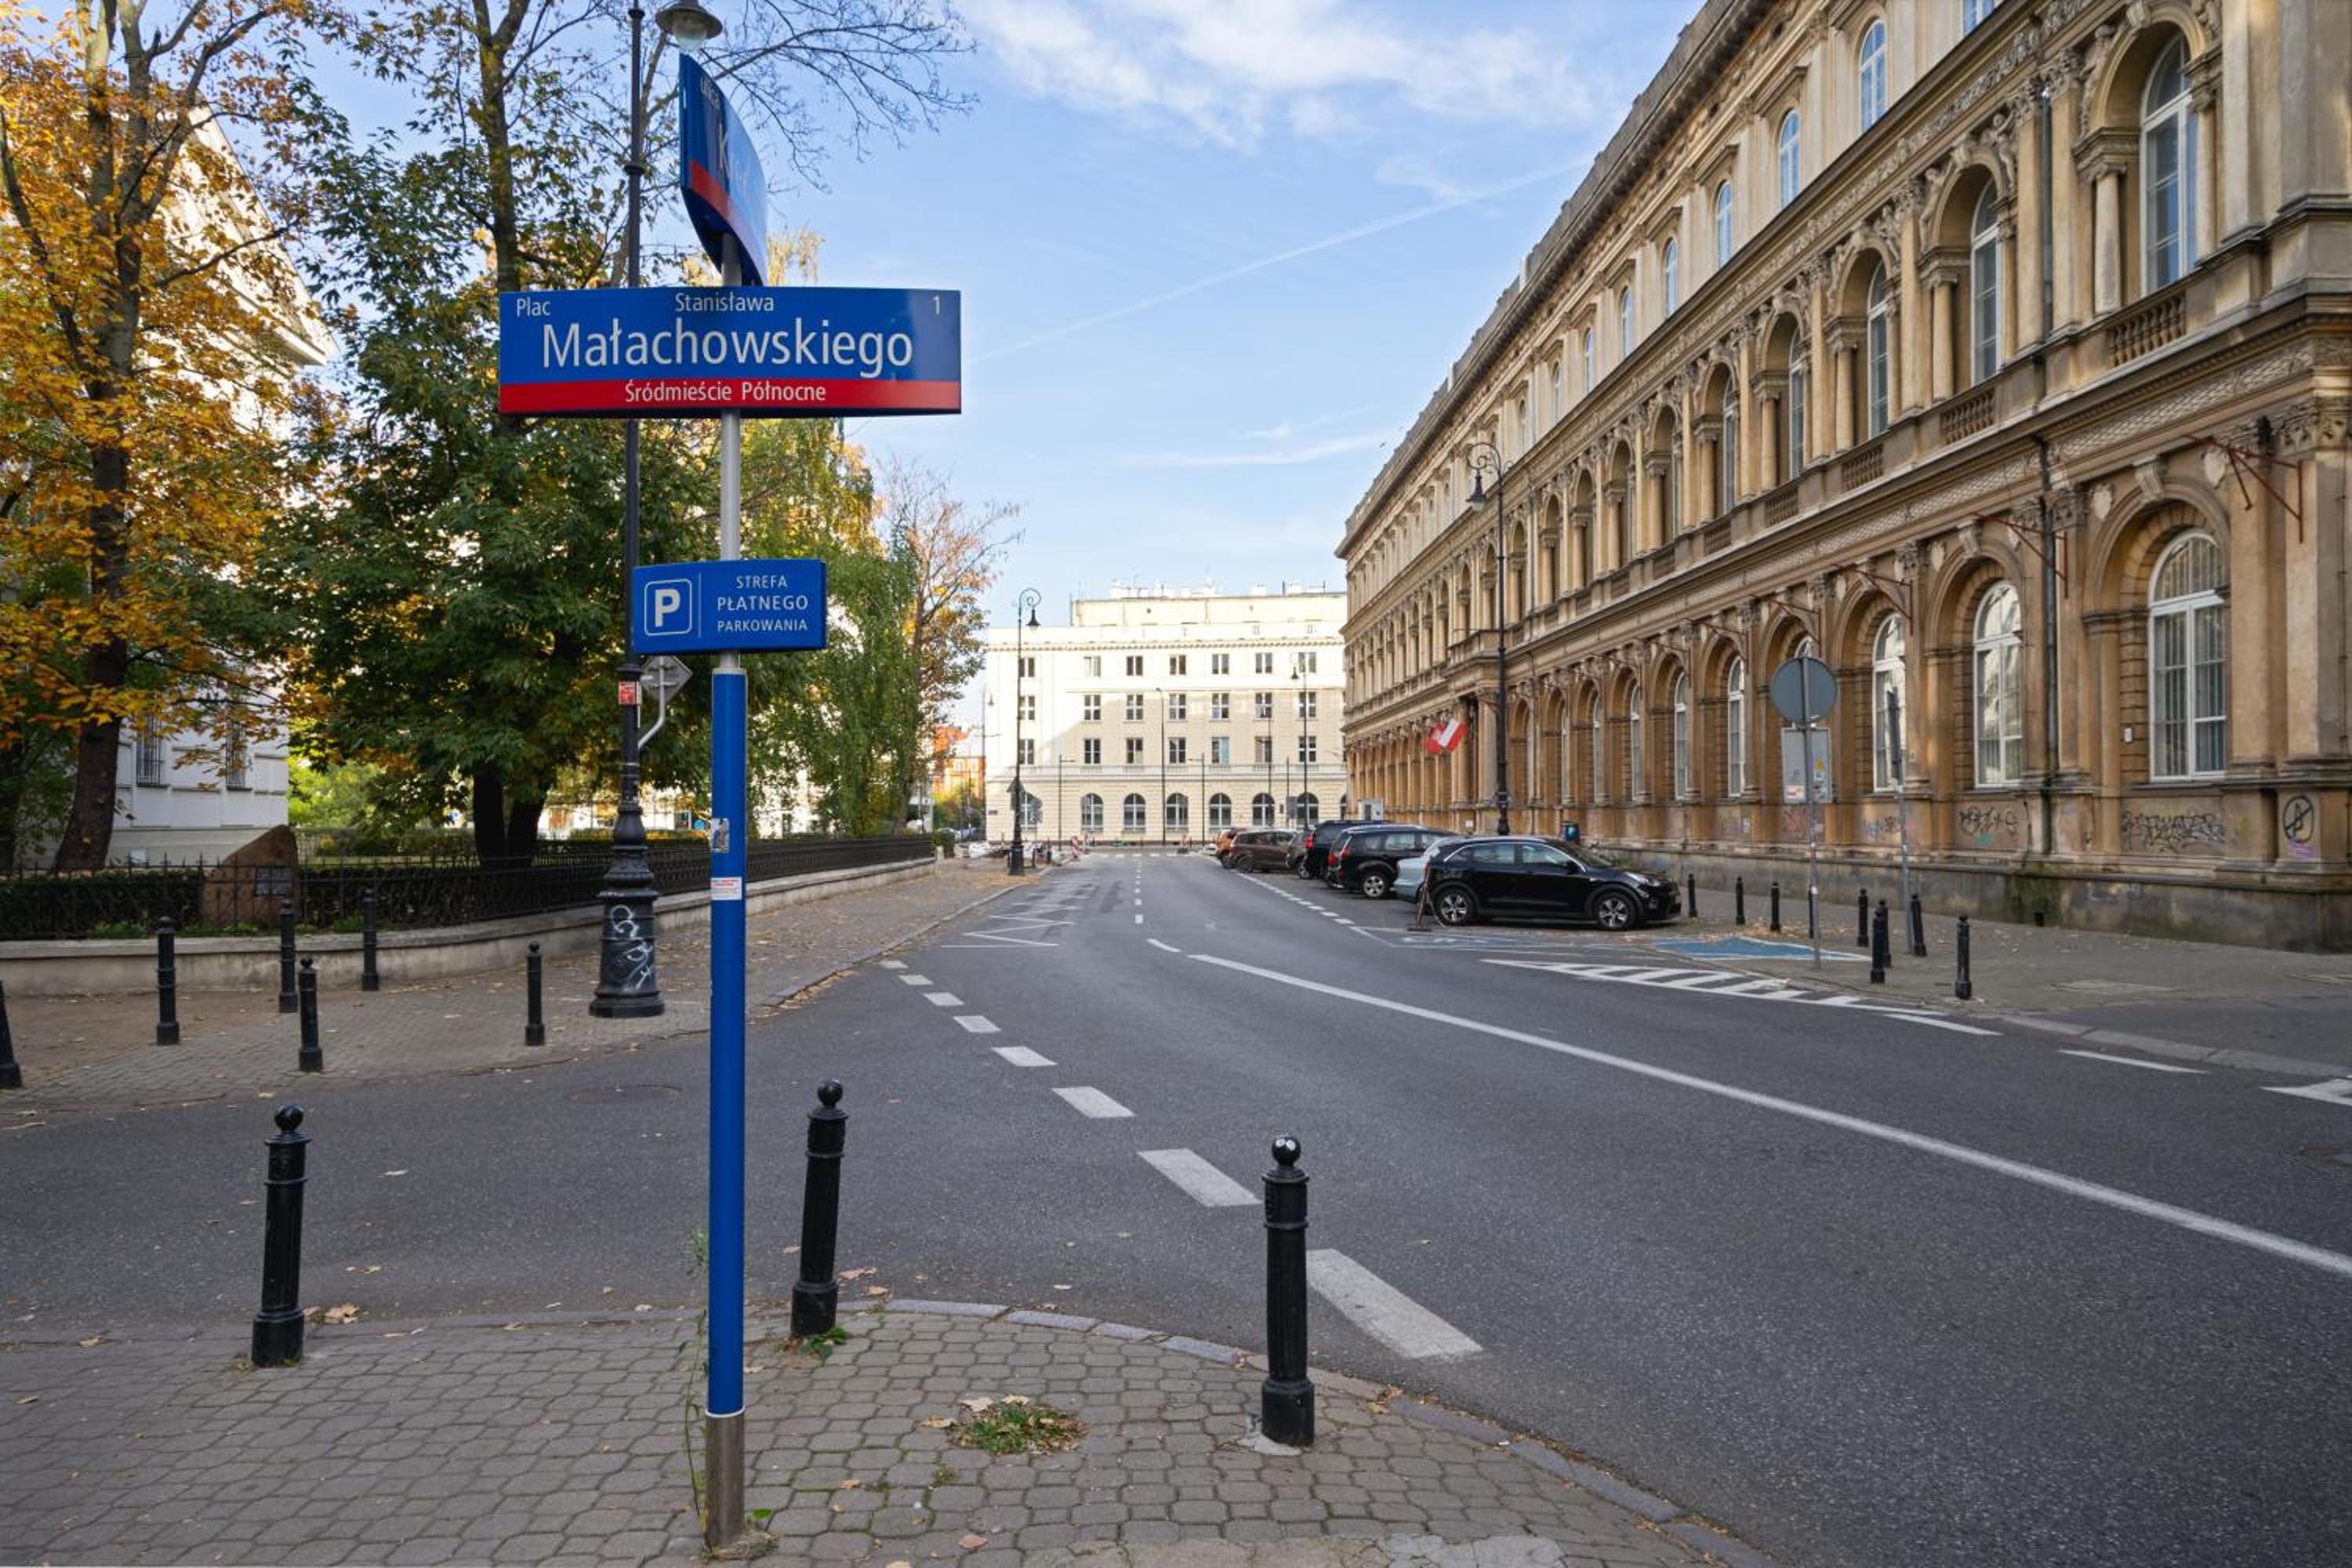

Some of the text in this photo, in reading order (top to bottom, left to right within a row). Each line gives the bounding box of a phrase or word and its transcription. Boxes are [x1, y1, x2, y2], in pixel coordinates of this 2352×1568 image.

[517, 291, 775, 318] Plac Stanisława
[932, 296, 941, 314] 1
[543, 317, 913, 378] Małachowskiego
[624, 379, 826, 402] Śródmieście Północne
[735, 575, 788, 589] STREFA
[655, 589, 681, 627] P
[717, 594, 809, 612] PŁATNEGO
[717, 618, 808, 633] PARKOWANIA
